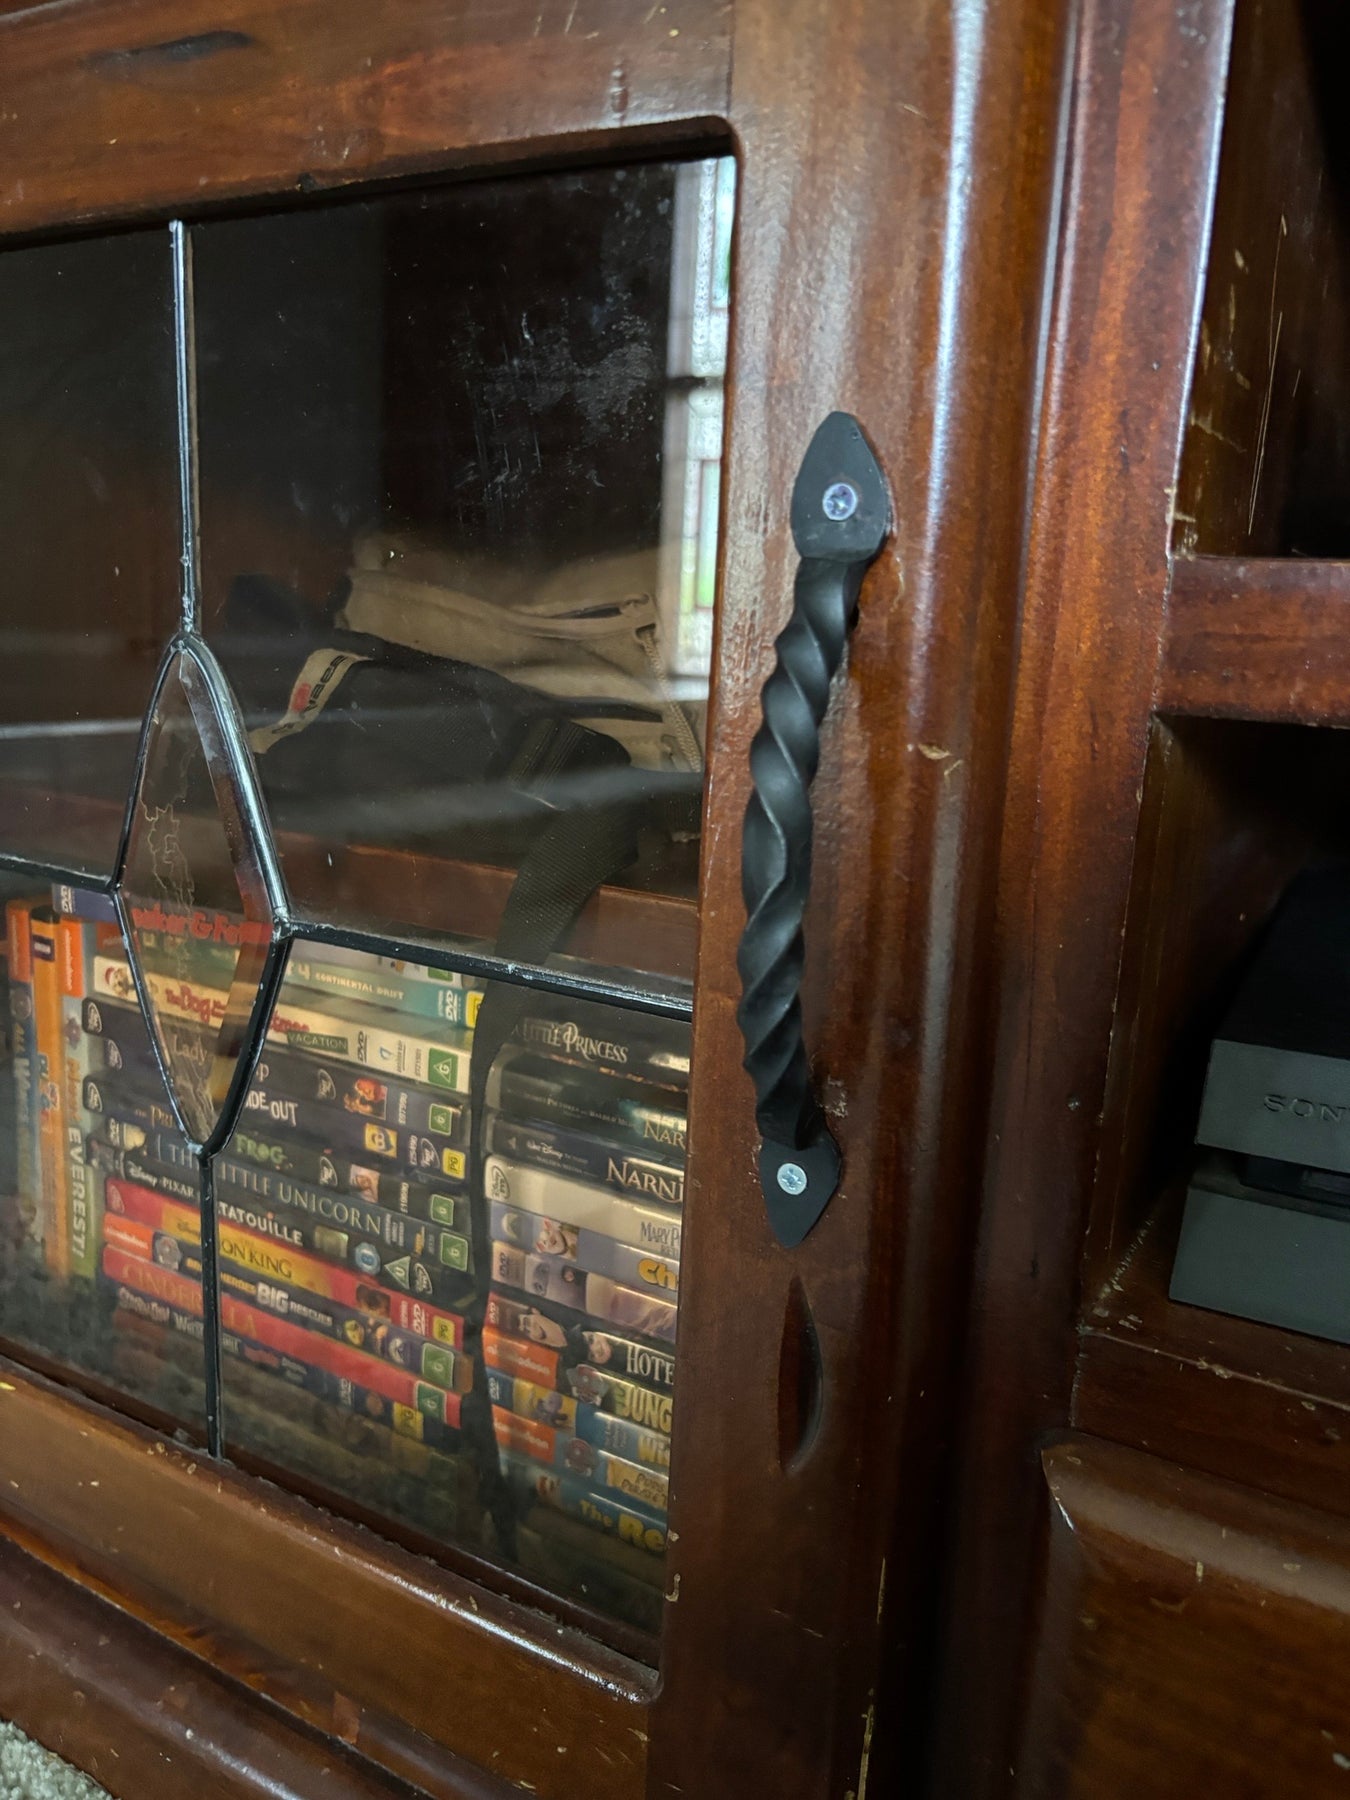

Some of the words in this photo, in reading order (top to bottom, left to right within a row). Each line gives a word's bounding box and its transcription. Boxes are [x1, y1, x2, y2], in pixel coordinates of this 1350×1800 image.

[287, 1030, 349, 1051] VACATION
[560, 1022, 629, 1063] PRINCESS
[270, 1099, 297, 1127] OUT
[1263, 1093, 1350, 1123] SON
[235, 1133, 287, 1164] FROG
[67, 1126, 87, 1260] EVEREST!
[278, 1181, 382, 1236] UNICORN
[250, 1252, 292, 1279] KING
[257, 1281, 290, 1314] BIG
